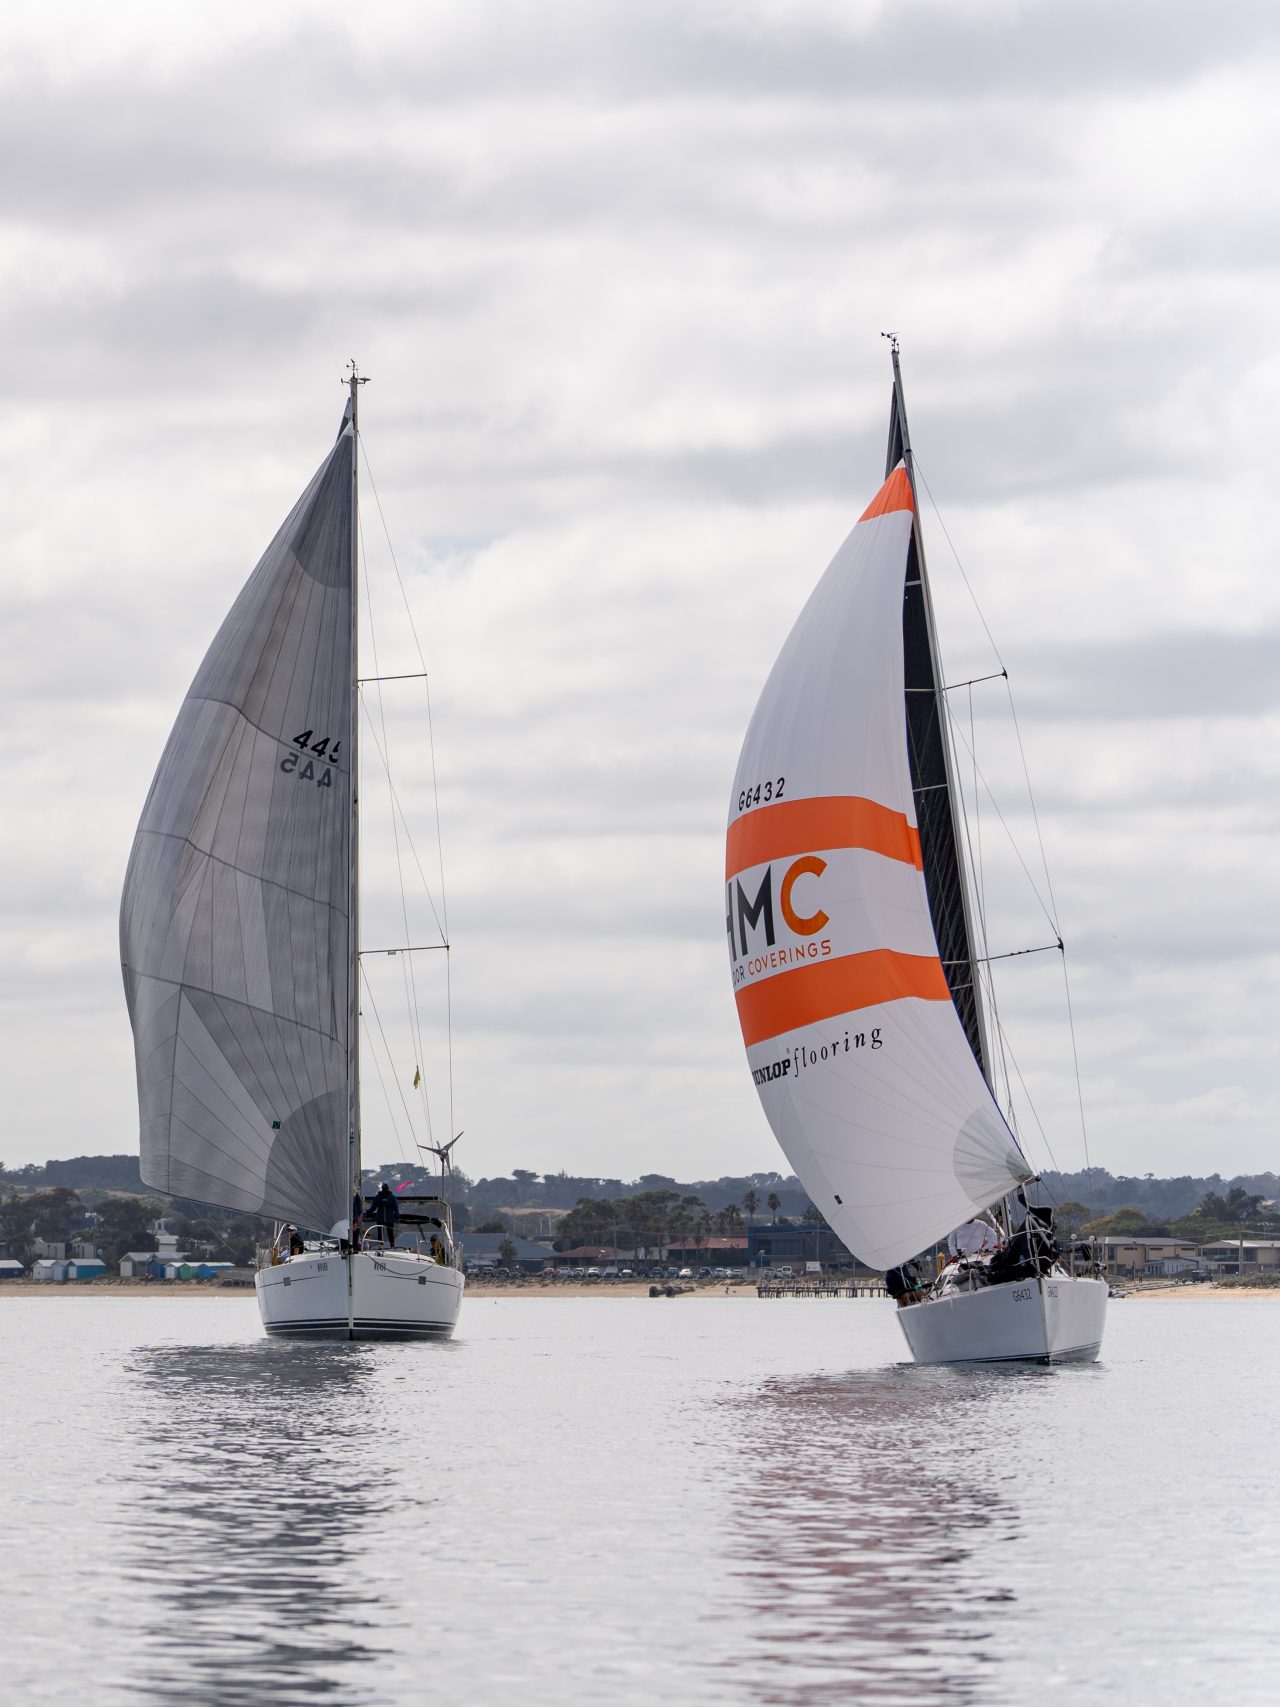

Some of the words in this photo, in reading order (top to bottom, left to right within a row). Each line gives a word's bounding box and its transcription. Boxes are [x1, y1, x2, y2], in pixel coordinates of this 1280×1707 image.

[739, 777, 785, 812] G6432
[748, 939, 832, 976] COVERINGS
[794, 1028, 883, 1078] flooring
